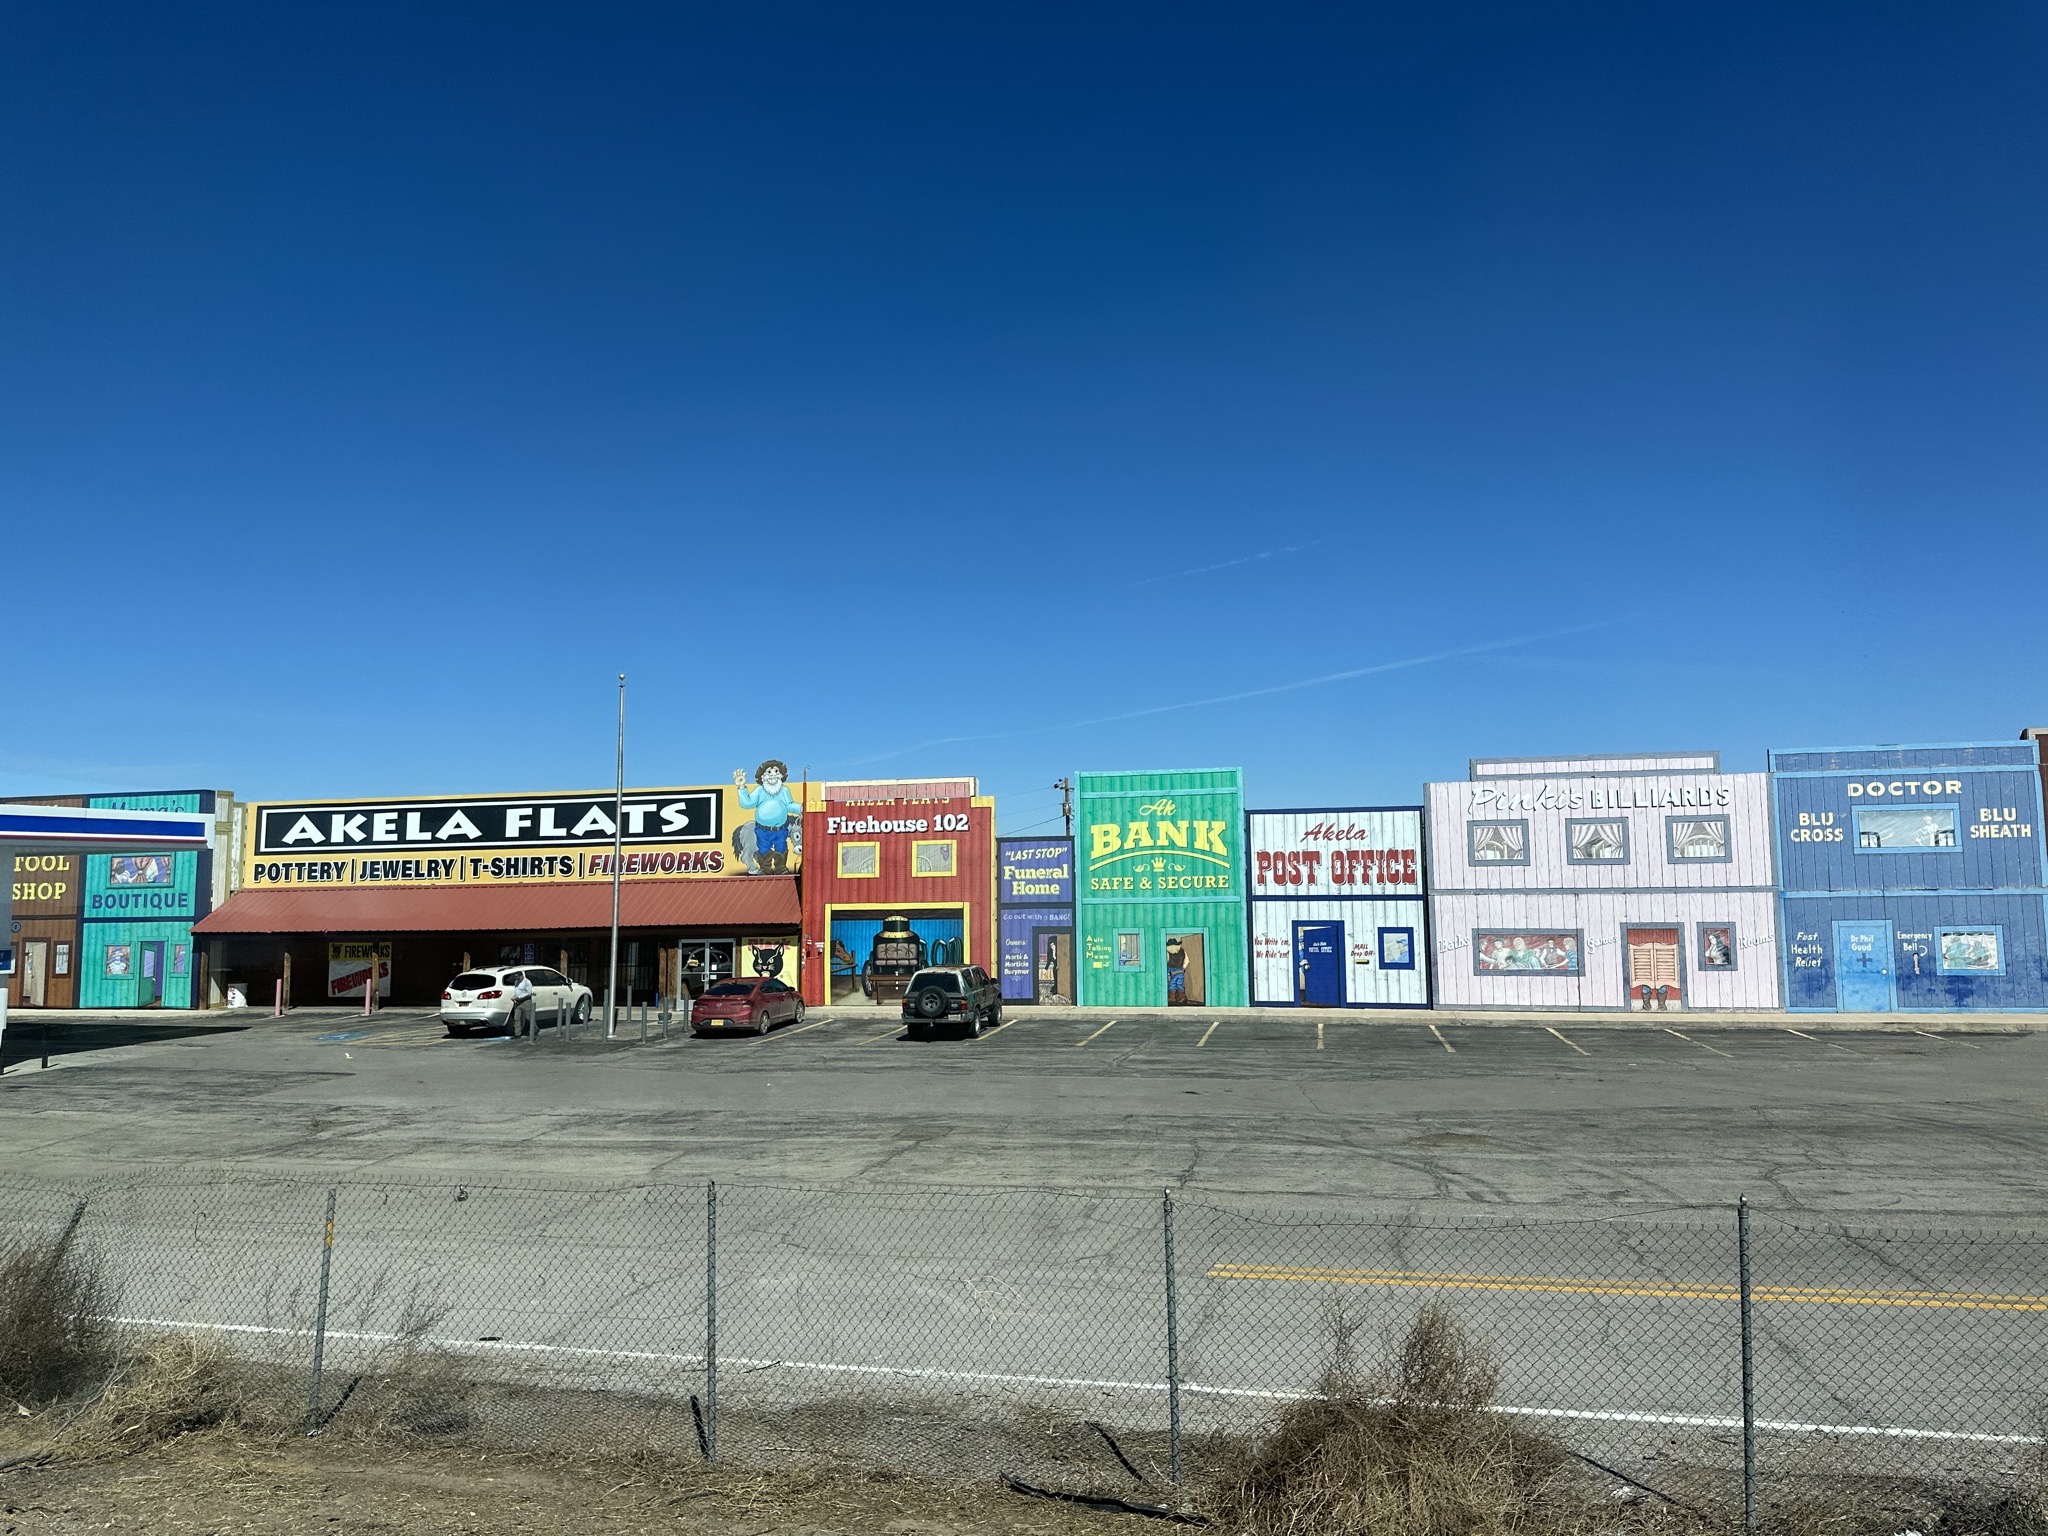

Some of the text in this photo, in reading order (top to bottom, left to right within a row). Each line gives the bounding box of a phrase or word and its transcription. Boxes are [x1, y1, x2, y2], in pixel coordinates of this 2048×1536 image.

[1847, 780, 1962, 797] DOCTOR
[1591, 785, 1730, 809] BILLIARDS
[1798, 812, 1834, 827] BLU
[1980, 807, 2017, 822] BLU
[281, 801, 690, 845] AKELA FLATS
[827, 813, 970, 834] Firehouse 102
[1970, 823, 2031, 839] SHEATH
[1090, 820, 1228, 860] BANK
[1300, 822, 1368, 842] Akela
[1790, 827, 1844, 842] CROSS
[254, 862, 348, 883] POTTERY
[359, 858, 457, 881] JEWELRY
[470, 855, 574, 878] T-SHIRTS
[1003, 864, 1069, 880] Funeral
[1256, 848, 1418, 886] POST OFFICE
[1012, 881, 1060, 895] Home
[1091, 875, 1229, 891] SAFE & SECURE
[12, 882, 67, 901] SHOP
[92, 893, 188, 910] BOUTIQUE
[1049, 913, 1071, 921] BANG!
[1738, 934, 1775, 950] Rooms
[1796, 931, 1818, 941] Fast
[1897, 931, 1932, 941] Emergency
[1587, 935, 1619, 954] Games
[1791, 944, 1823, 955] Health
[1903, 943, 1918, 951] Bell
[1264, 949, 1277, 958] Ride
[1795, 956, 1823, 967] Relief
